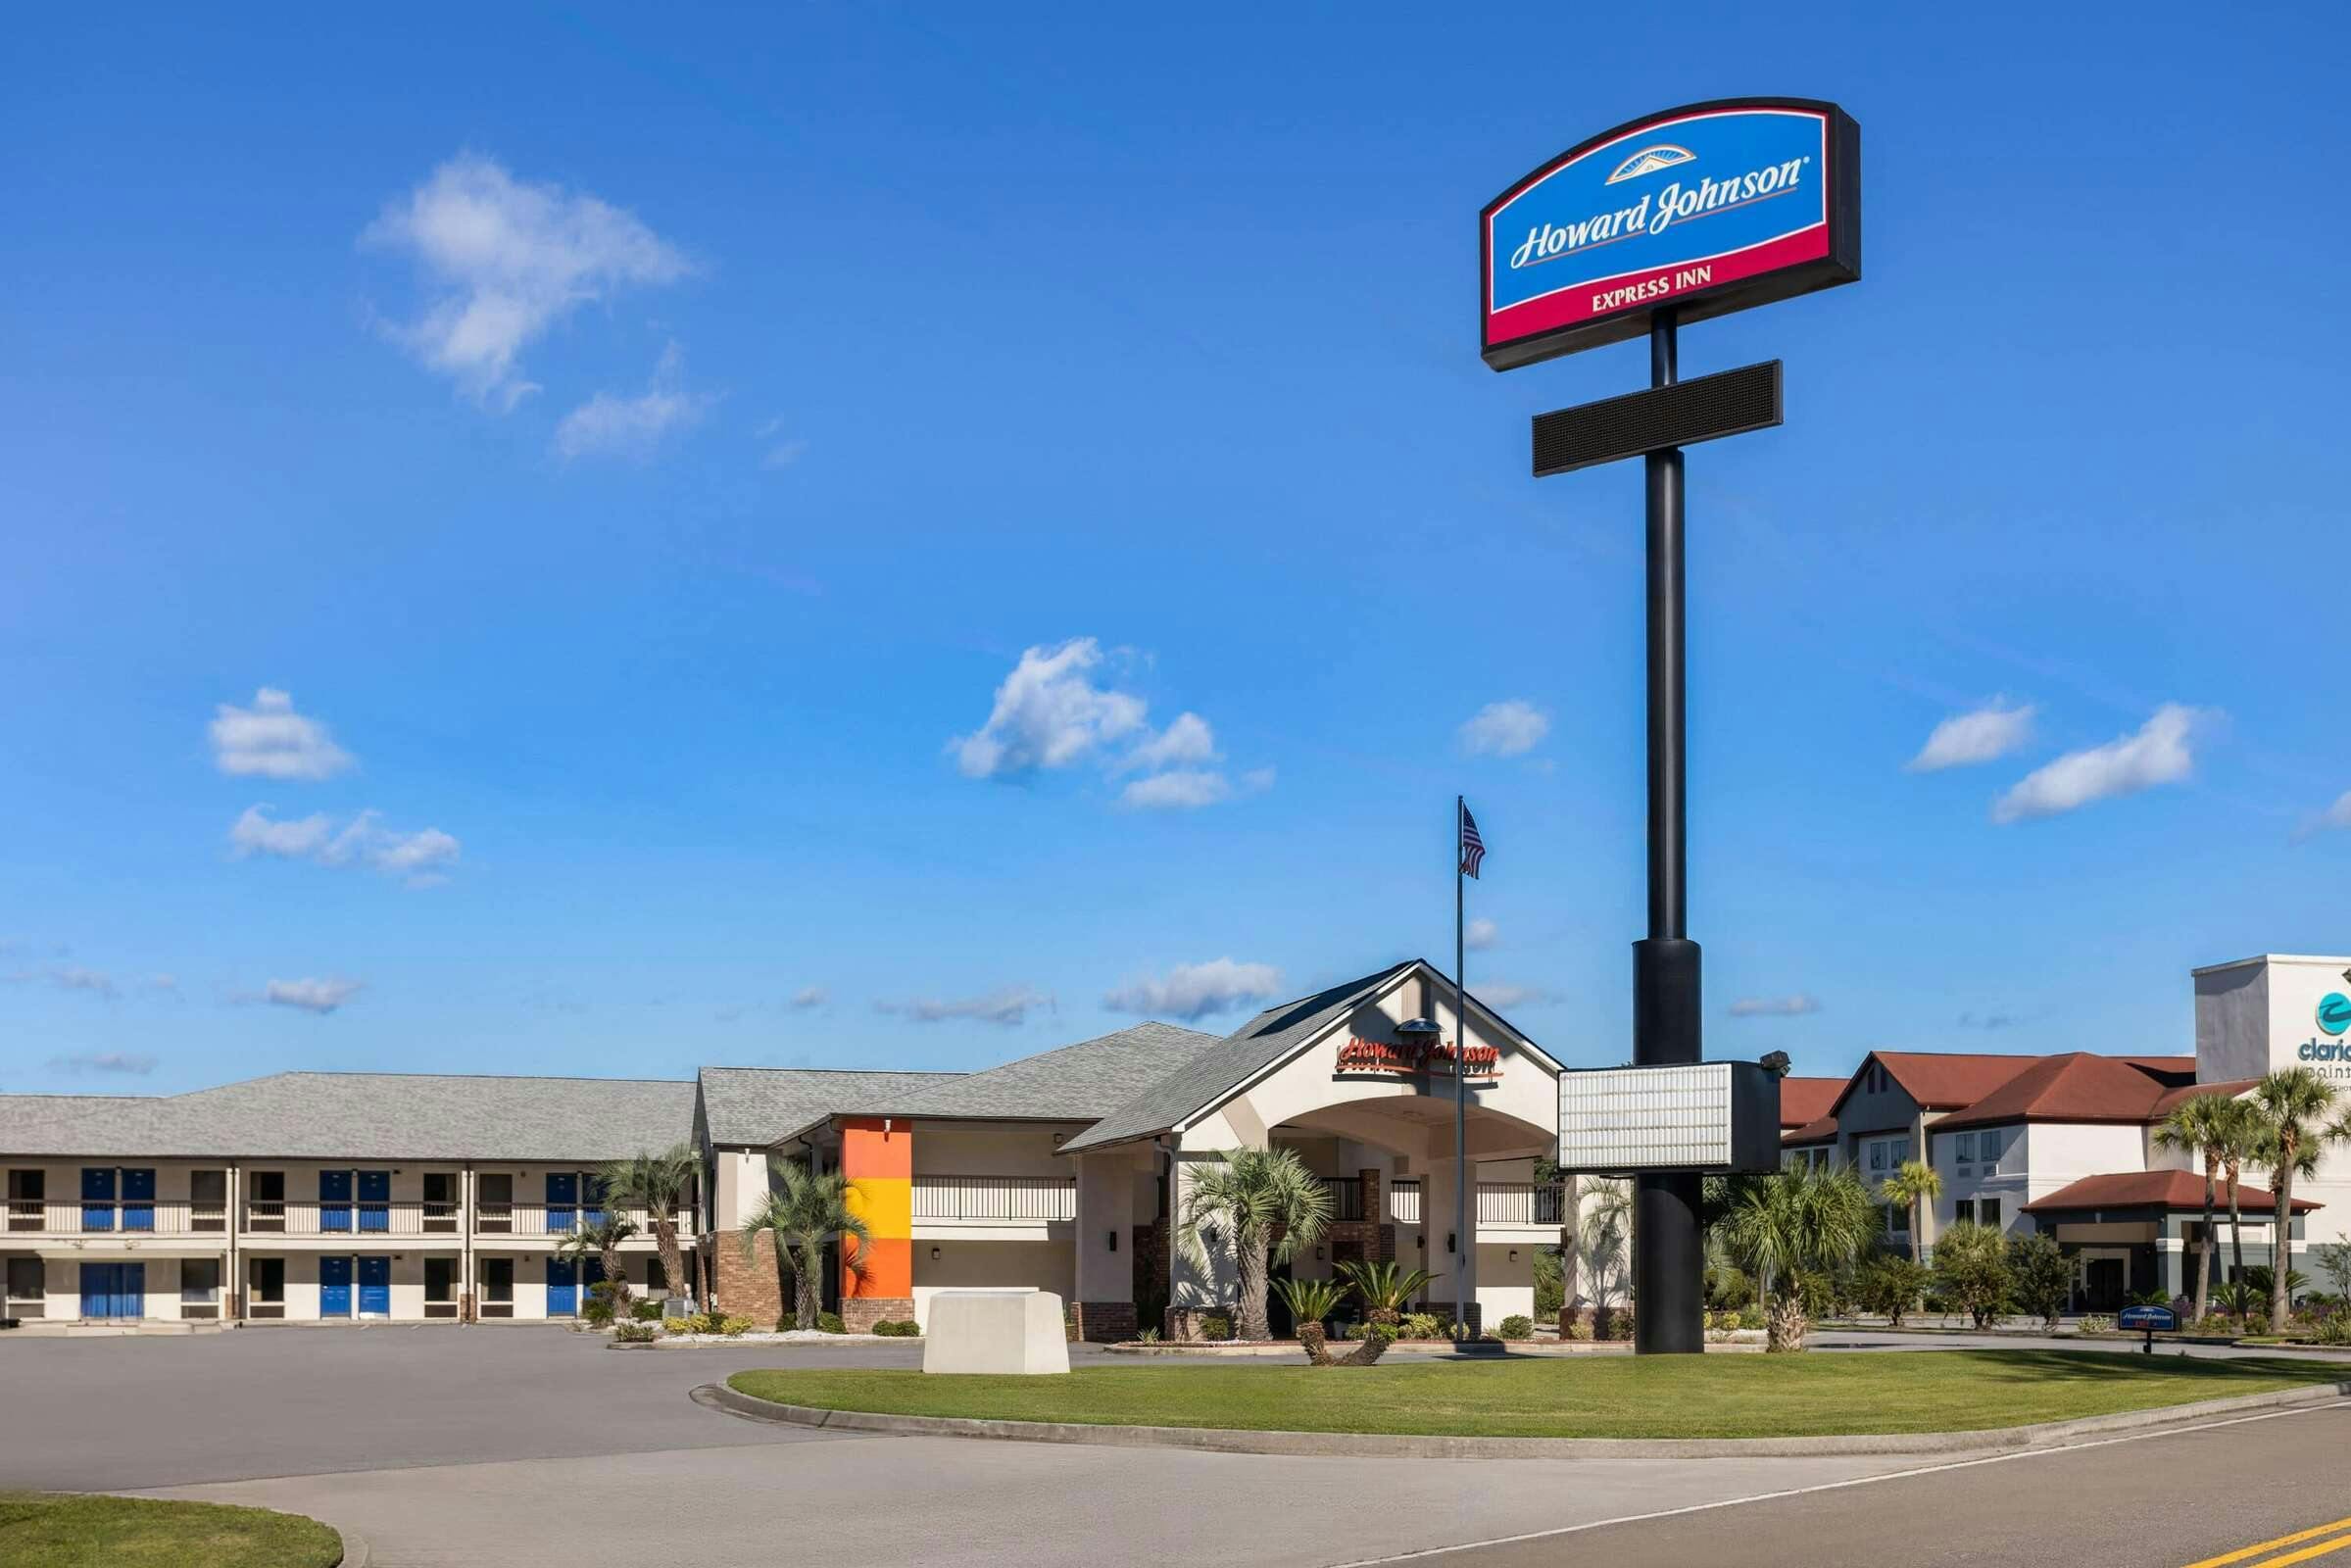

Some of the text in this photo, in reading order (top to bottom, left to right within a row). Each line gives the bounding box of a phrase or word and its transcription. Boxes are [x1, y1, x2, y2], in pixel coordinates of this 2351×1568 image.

[1510, 158, 1802, 270] Howard Johnson
[1592, 265, 1711, 312] EXPRESS INN
